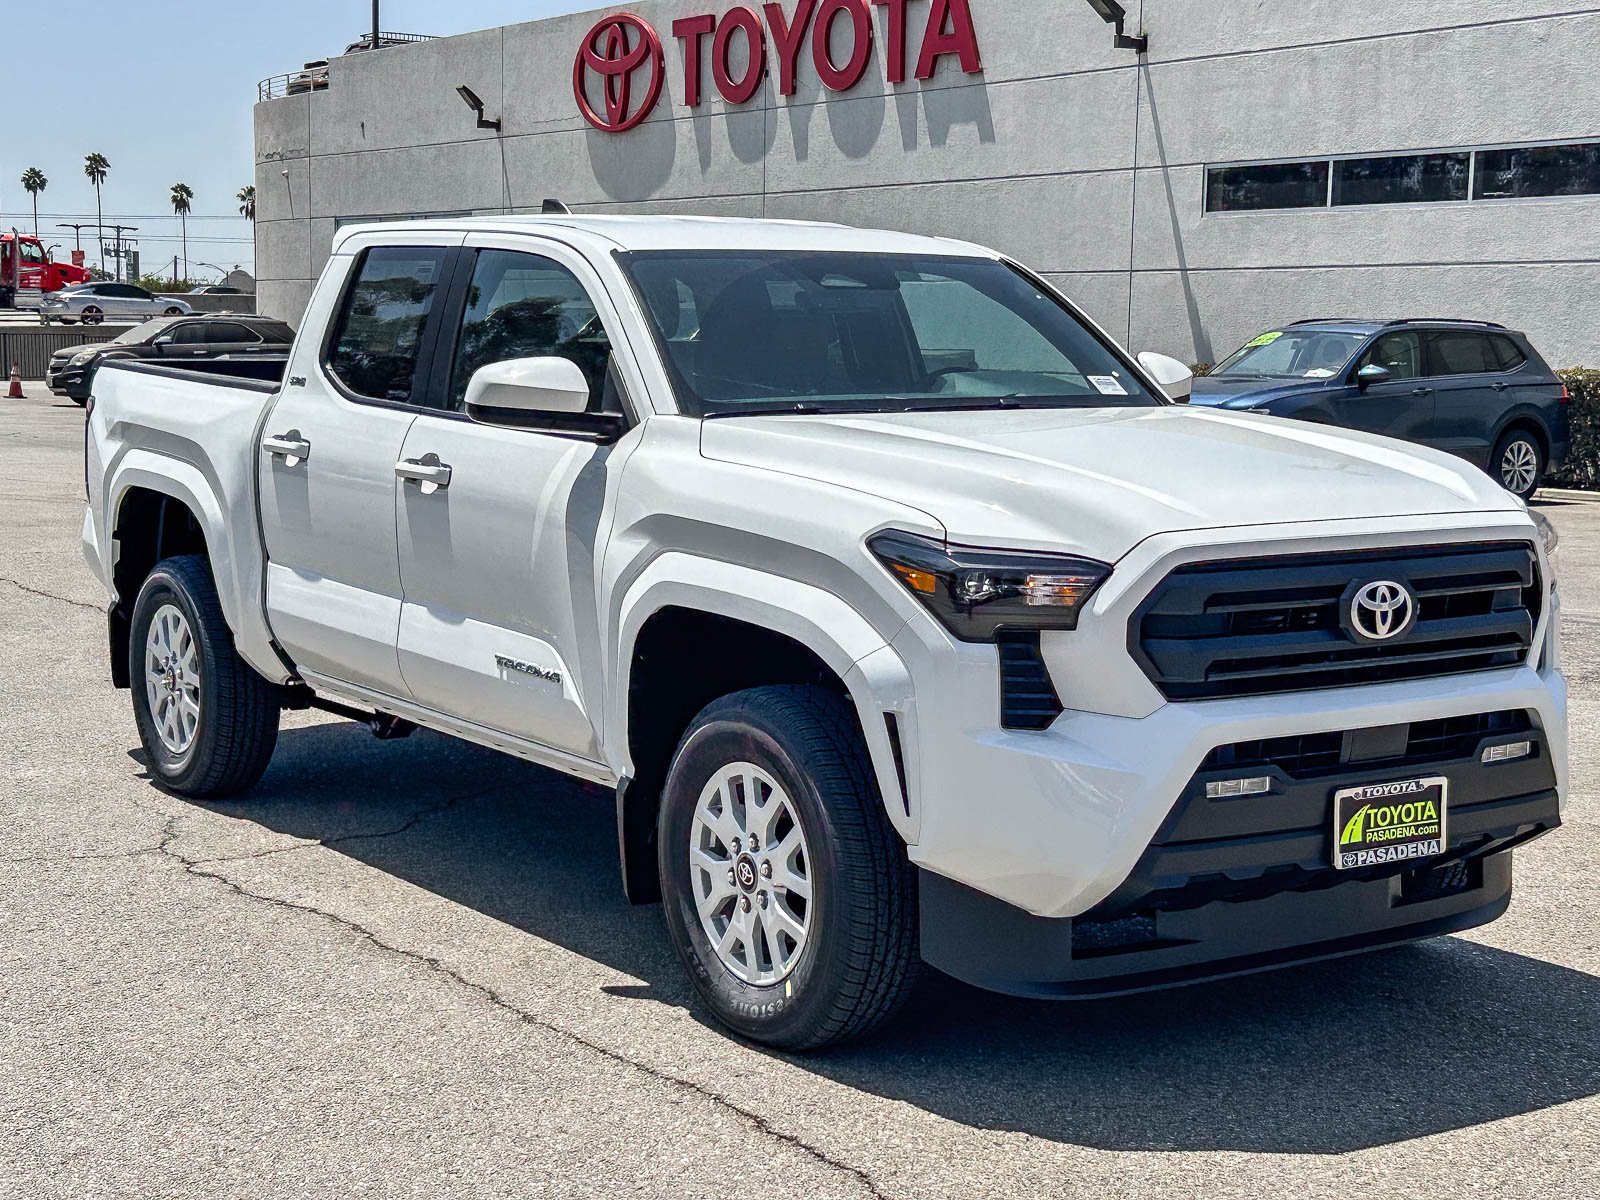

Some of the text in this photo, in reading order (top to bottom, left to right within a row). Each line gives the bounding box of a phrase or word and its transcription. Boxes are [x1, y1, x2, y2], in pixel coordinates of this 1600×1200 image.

[672, 0, 981, 106] TOYOTA
[1365, 781, 1417, 798] TOYOTA
[1366, 800, 1437, 828] TOYOTA
[1366, 824, 1439, 844] PASADENA.com
[1357, 840, 1439, 865] PASADENA
